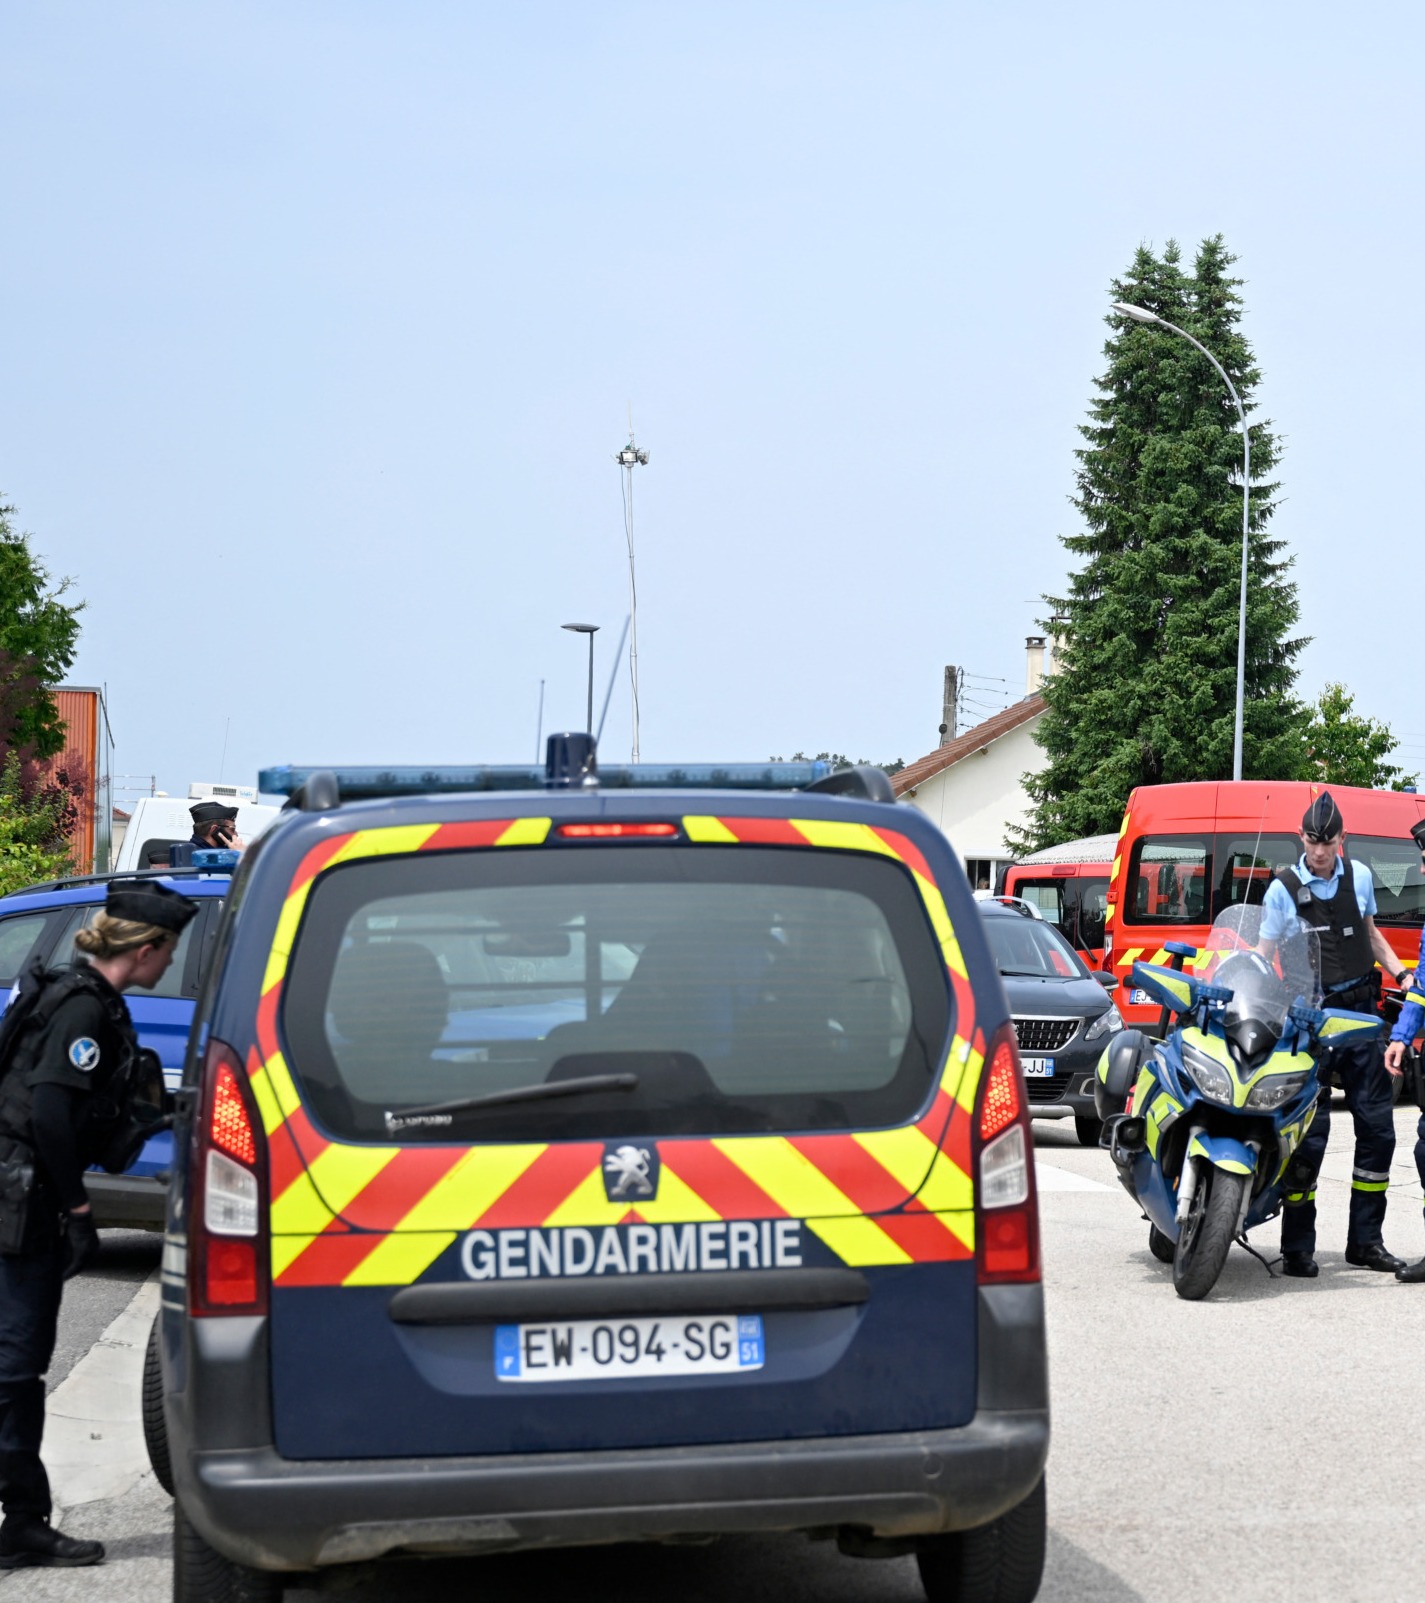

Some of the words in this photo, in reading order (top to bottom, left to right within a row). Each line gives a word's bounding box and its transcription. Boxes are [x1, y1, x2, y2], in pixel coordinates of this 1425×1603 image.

[460, 1220, 802, 1280] GENDARMERIE
[524, 1321, 732, 1368] EW-094-SG
[741, 1341, 759, 1361] 51
